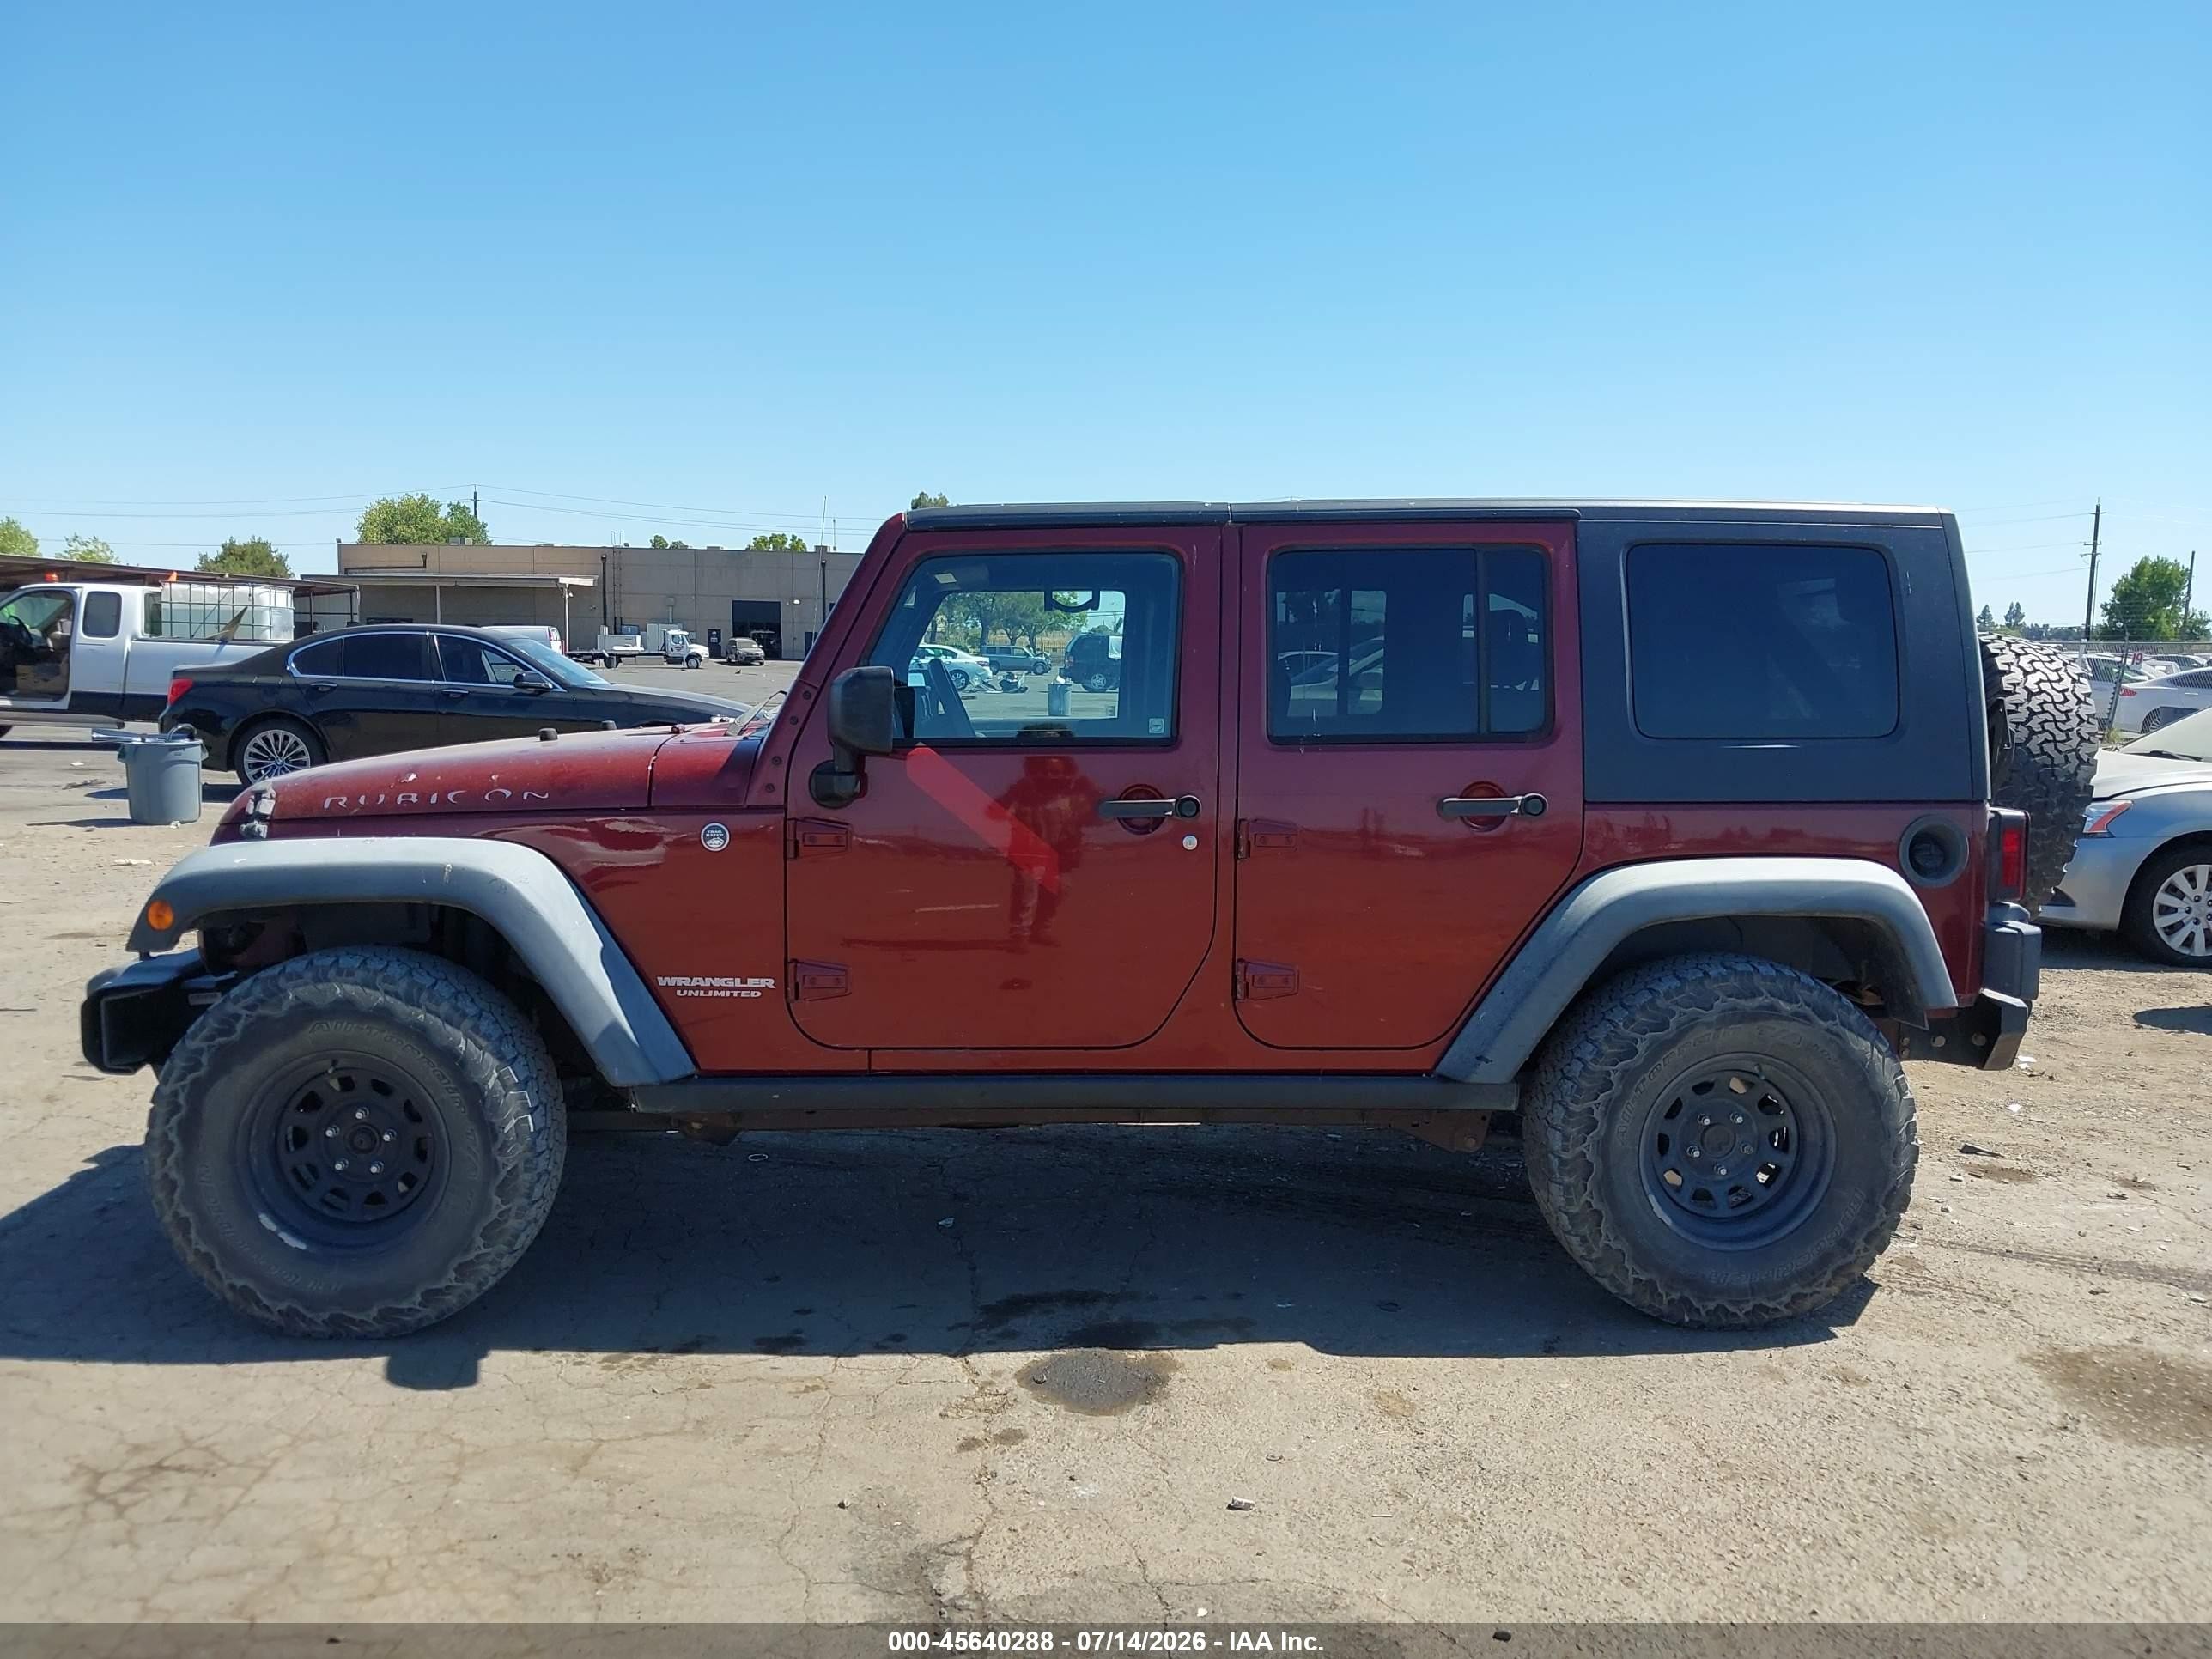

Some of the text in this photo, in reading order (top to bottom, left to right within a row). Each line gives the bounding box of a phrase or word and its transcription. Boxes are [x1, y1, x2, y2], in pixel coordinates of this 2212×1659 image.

[2131, 653, 2143, 665] 19
[323, 787, 549, 810] RUBICON
[656, 976, 776, 989] WRANGLER
[676, 989, 763, 998] UNLIMITED
